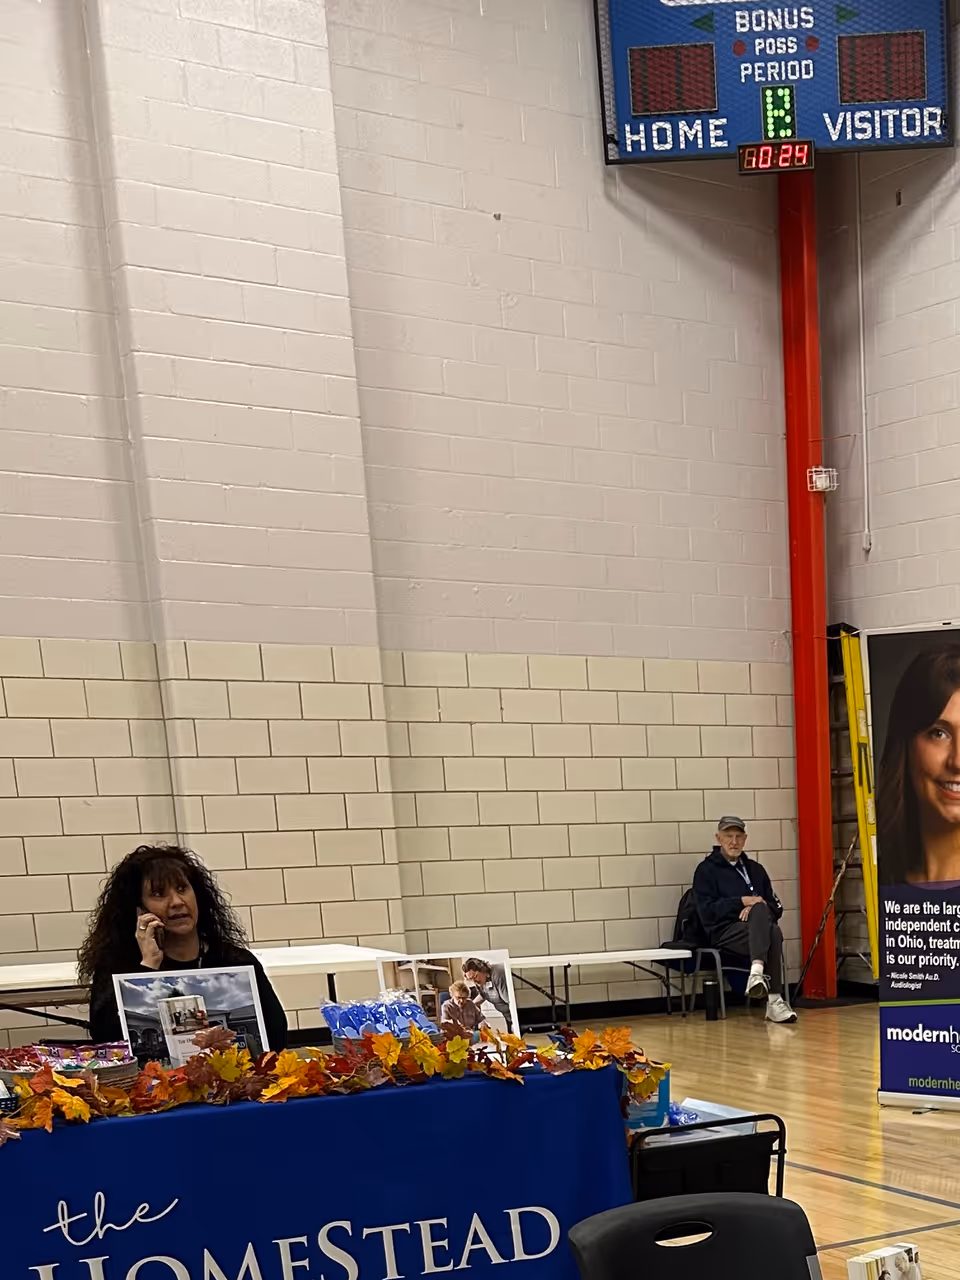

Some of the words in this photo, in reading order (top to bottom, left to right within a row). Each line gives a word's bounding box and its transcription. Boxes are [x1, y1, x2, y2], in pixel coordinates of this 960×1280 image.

[735, 7, 815, 33] BONUS
[755, 37, 798, 56] POSS
[740, 59, 814, 83] PERIOD
[624, 117, 729, 152] HOME
[823, 106, 945, 142] VISITOR
[884, 900, 901, 914] We
[903, 902, 921, 914] are
[922, 901, 941, 915] the
[885, 918, 952, 934] independent
[885, 934, 896, 948] in
[898, 934, 927, 951] Ohio,
[886, 951, 895, 964] is
[897, 953, 917, 965] our
[918, 952, 960, 970] priority.
[43, 1191, 180, 1246] the
